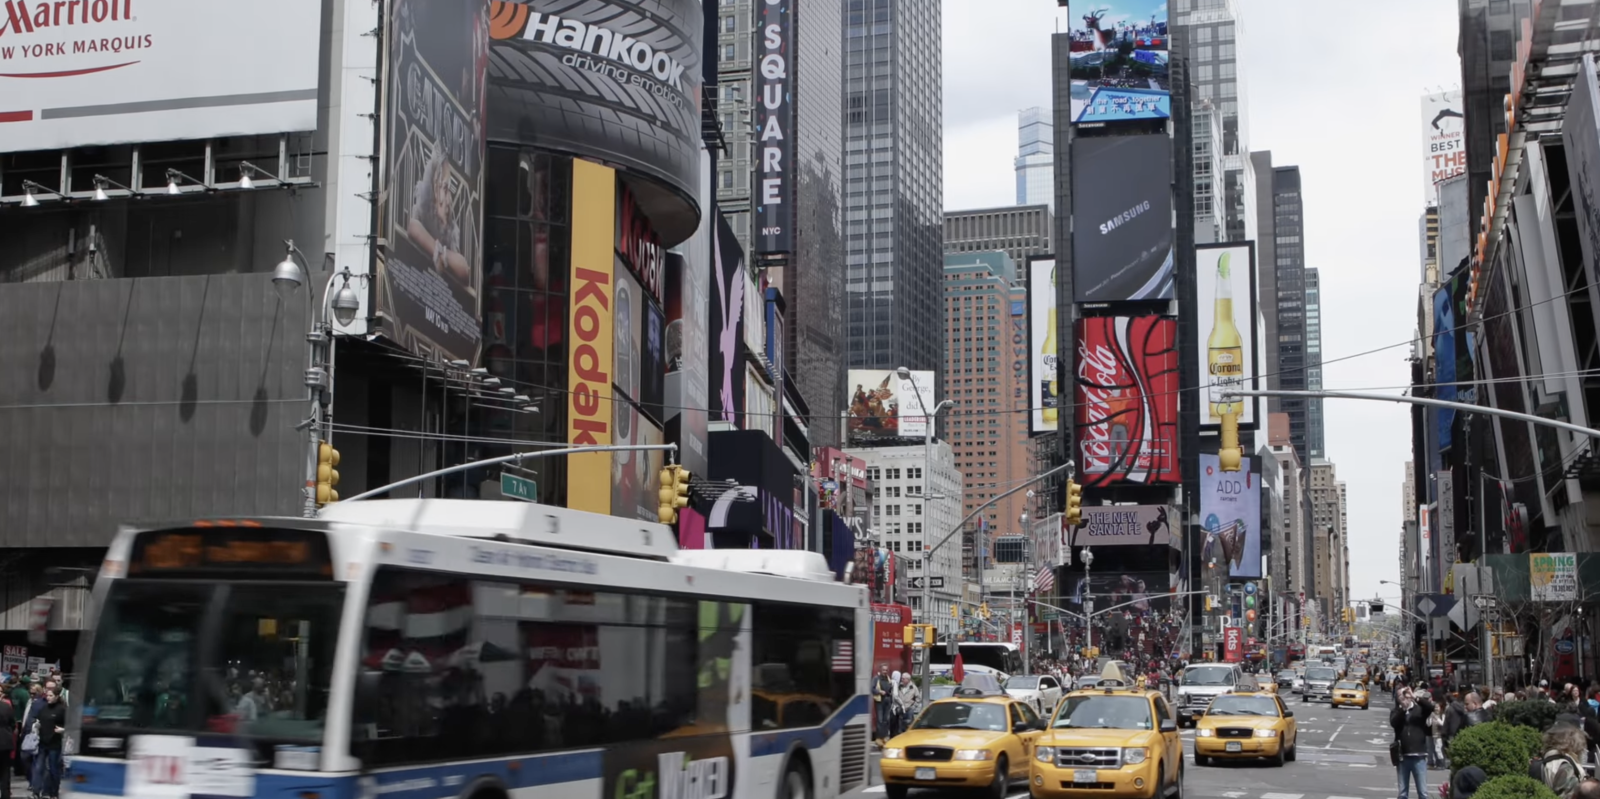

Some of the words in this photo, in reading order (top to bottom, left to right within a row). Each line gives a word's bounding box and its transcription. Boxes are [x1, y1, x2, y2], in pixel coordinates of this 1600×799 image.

[21, 42, 66, 58] YORK
[73, 34, 153, 54] MARQUIS
[562, 53, 628, 84] driving
[630, 74, 684, 109] emotion
[760, 24, 786, 205] SQUARE
[1431, 132, 1460, 141] WINNER
[1431, 139, 1461, 152] BEST
[1099, 200, 1150, 235] SAMSUNG
[762, 227, 781, 236] NYC
[573, 266, 610, 454] Kodak
[1012, 319, 1022, 413] NOVOTEL
[512, 480, 517, 493] 7
[1216, 480, 1242, 495] ADD
[1089, 511, 1110, 524] THE
[1112, 511, 1139, 524] NEW
[1089, 523, 1126, 536] SANTA
[1127, 523, 1142, 535] FE
[1534, 555, 1574, 566] SPRING
[1228, 629, 1239, 650] tkts
[5, 645, 27, 657] SALE
